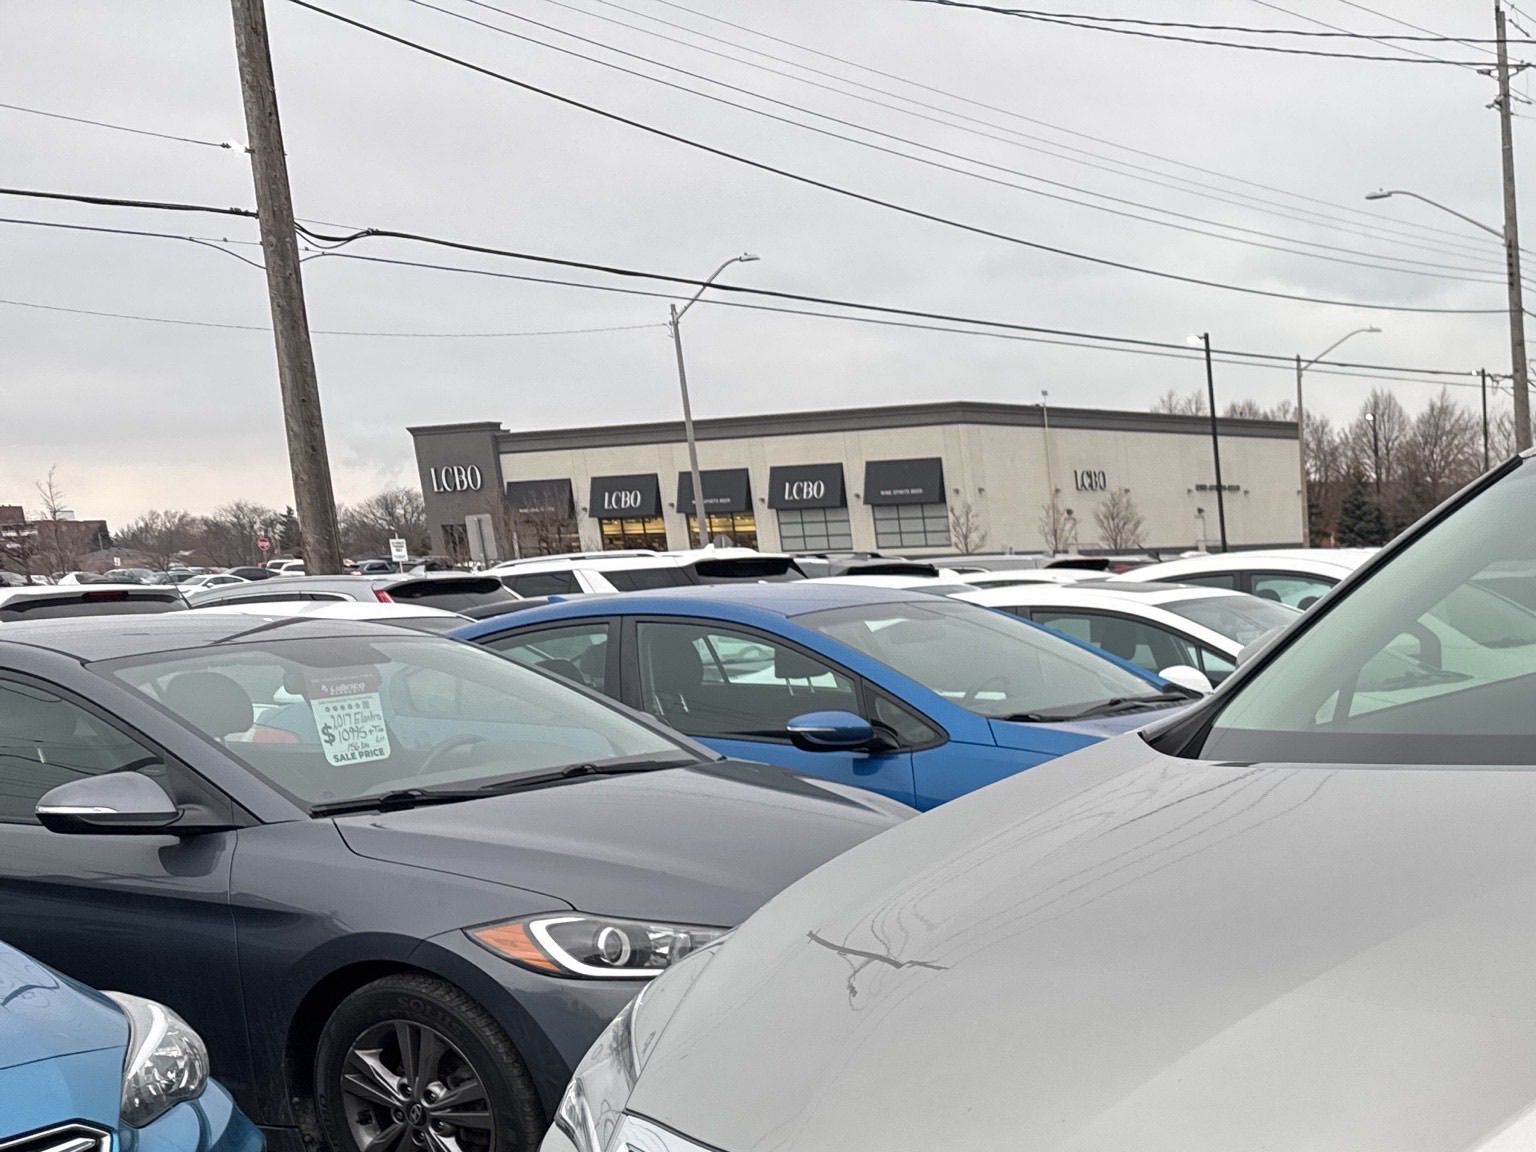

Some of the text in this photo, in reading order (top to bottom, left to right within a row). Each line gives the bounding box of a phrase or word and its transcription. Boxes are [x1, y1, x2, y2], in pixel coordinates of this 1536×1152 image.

[430, 464, 482, 493] LCBO
[604, 490, 641, 510] LCBO
[784, 480, 825, 501] LCBO
[330, 714, 352, 731] 2017
[321, 723, 336, 746] $
[333, 748, 385, 763] SALE PRICE
